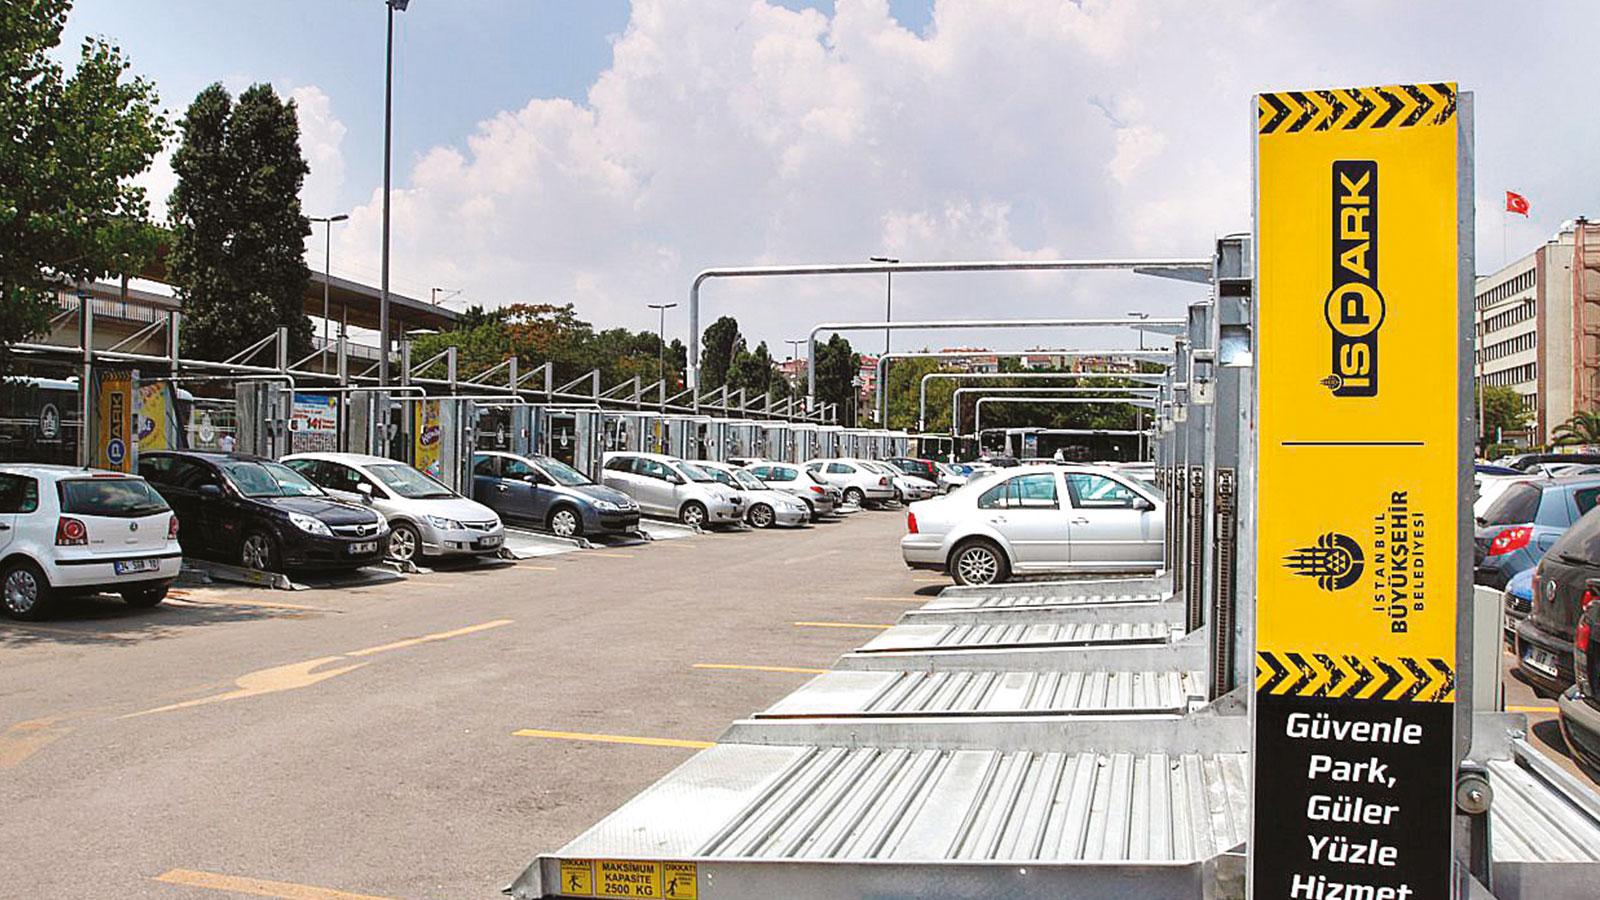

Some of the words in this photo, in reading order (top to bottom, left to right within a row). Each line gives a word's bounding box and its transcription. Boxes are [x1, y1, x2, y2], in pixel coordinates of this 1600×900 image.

[1373, 513, 1385, 611] İSTANBUL
[1388, 490, 1409, 633] BÜYÜKŞEHİR
[1412, 512, 1425, 611] BELEDİYESİ
[1286, 712, 1422, 744] Güvenle
[1308, 754, 1396, 788] Park,
[1307, 795, 1400, 825] Güler
[1307, 834, 1398, 866] Yüzle
[602, 862, 655, 873] MAKSİMUM
[605, 872, 651, 884] KAPASİTE
[605, 883, 630, 894] 2500
[636, 885, 653, 896] KG
[1290, 874, 1413, 900] Hizmet
